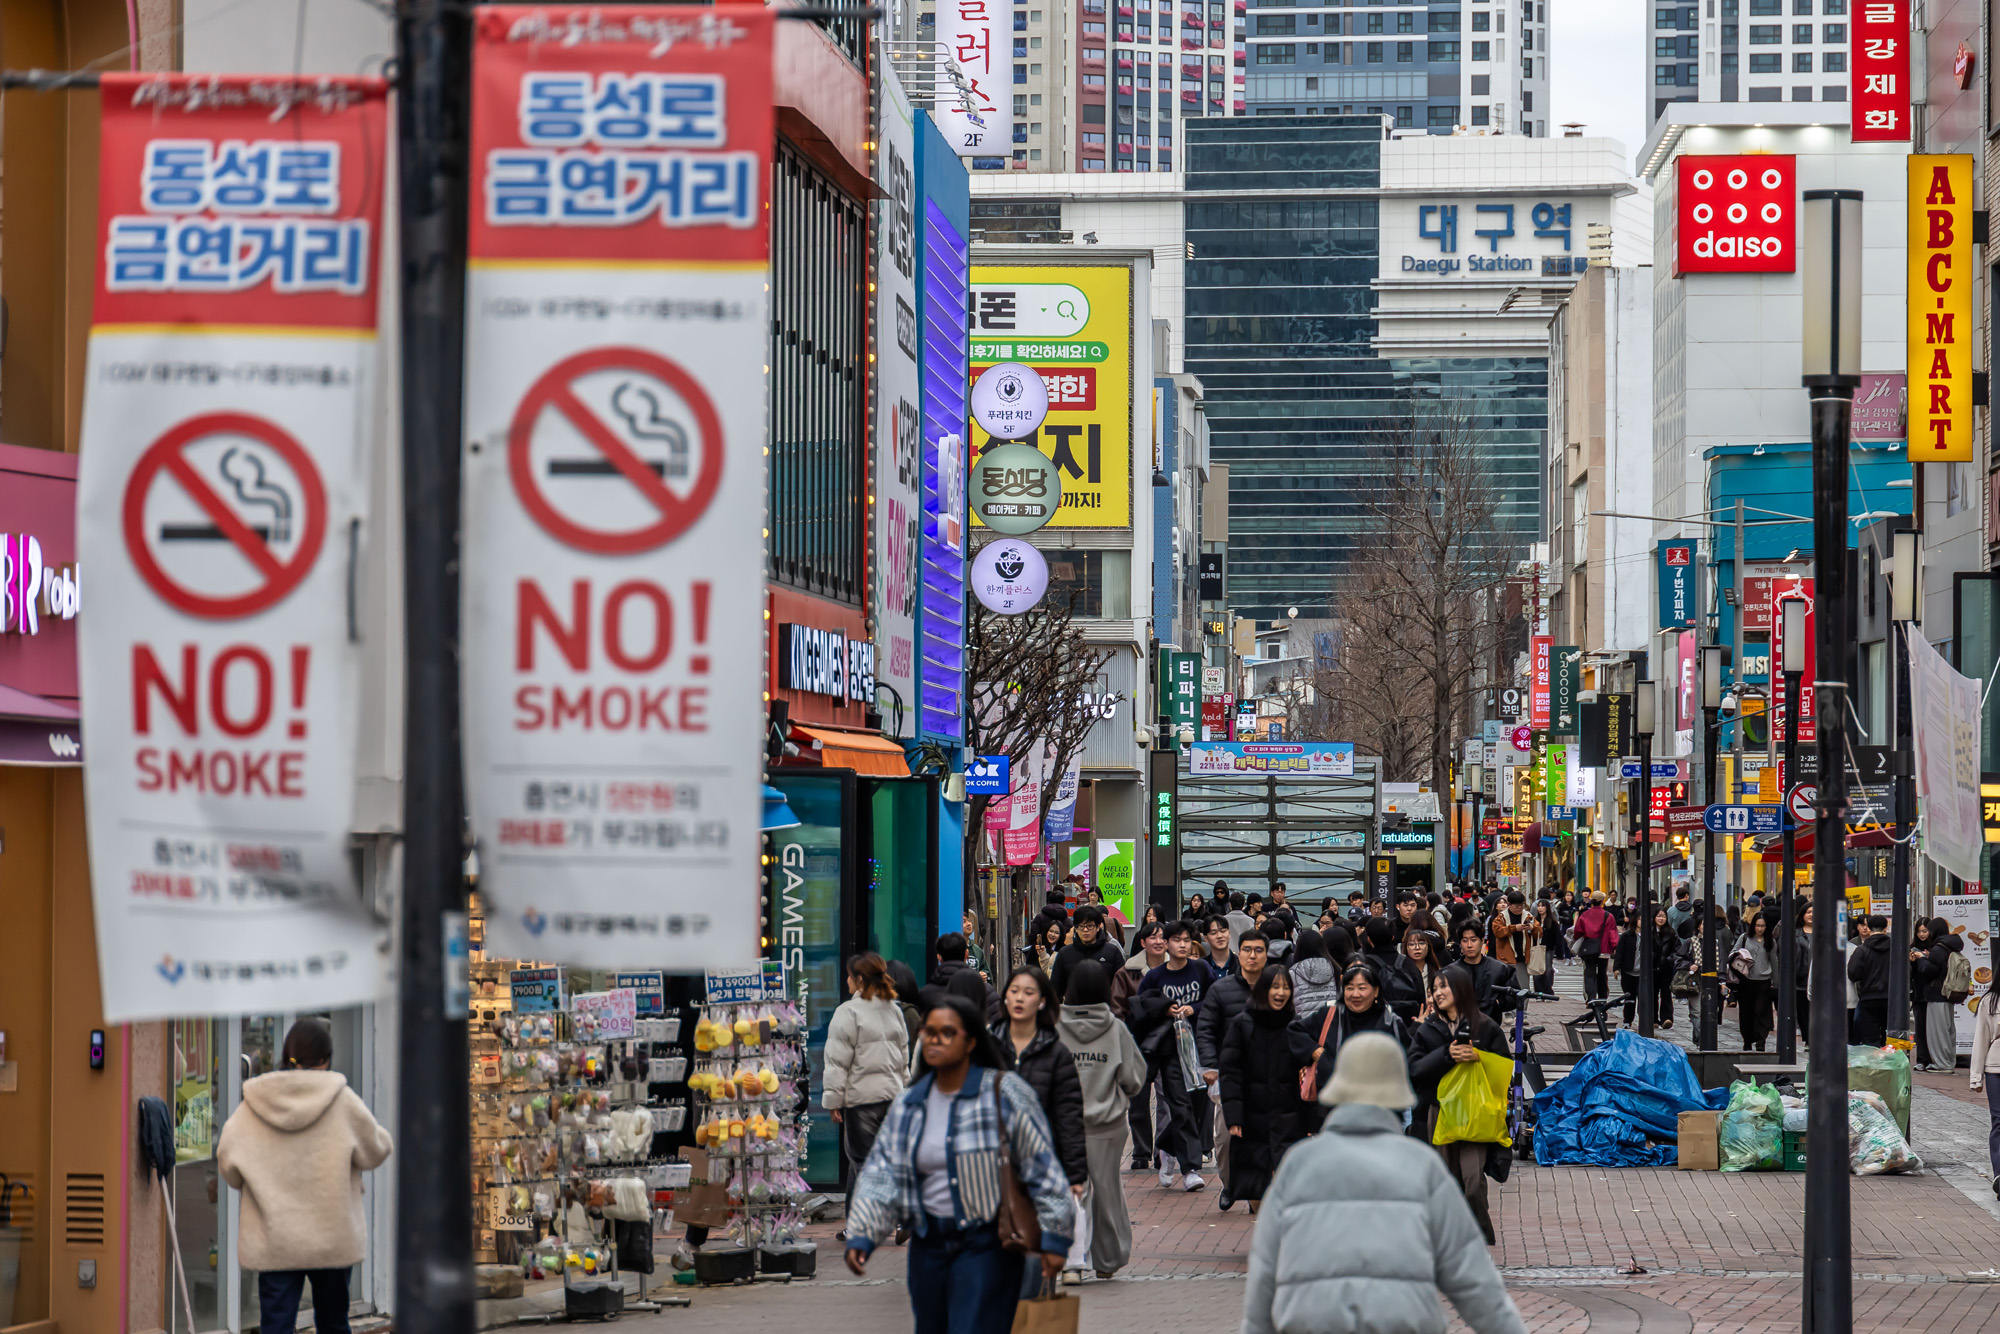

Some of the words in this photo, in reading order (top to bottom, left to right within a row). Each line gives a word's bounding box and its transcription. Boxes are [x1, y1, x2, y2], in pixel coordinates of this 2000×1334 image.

[1863, 3, 1898, 130] 금강제화
[522, 72, 726, 148] 동성로
[964, 133, 983, 148] 2F
[144, 141, 341, 213] 동성로
[486, 150, 759, 226] 금연거리
[1419, 202, 1572, 253] 대구역
[106, 216, 369, 294] 금연거리
[1693, 230, 1782, 258] daiso
[1401, 255, 1461, 275] Daegu
[1467, 253, 1533, 272] Station
[969, 292, 1016, 329] 폰
[1016, 344, 1086, 359] 확인하세요!
[987, 410, 1013, 420] 푸라닭
[1015, 410, 1032, 420] 치킨
[1003, 425, 1015, 434] 5F
[987, 504, 1018, 516] 베이커리
[1024, 504, 1041, 515] 카페
[1057, 492, 1101, 508] 까지!
[985, 584, 1033, 597] 한끼플러스
[1003, 600, 1014, 609] 2F
[1673, 567, 1685, 621] 7번가피자
[516, 579, 713, 674] NO!
[1206, 669, 1219, 677] CCR
[1537, 642, 1549, 685] 제이원
[131, 645, 311, 739] NO!
[1559, 651, 1569, 722] CROCODIL
[514, 686, 709, 732] SMOKE
[136, 747, 307, 798] SMOKE
[1235, 755, 1267, 770] 캐릭터
[1268, 757, 1309, 770] 스트리트
[1157, 792, 1171, 847] 質優價廉
[782, 843, 804, 972] GAMES
[1954, 898, 1984, 906] BAKERY
[513, 984, 543, 997] 7900원
[709, 978, 723, 989] 1개
[726, 976, 760, 987] 5900원
[716, 989, 732, 999] 2개
[735, 987, 754, 999] 만원
[1070, 1052, 1108, 1063] NTIALS
